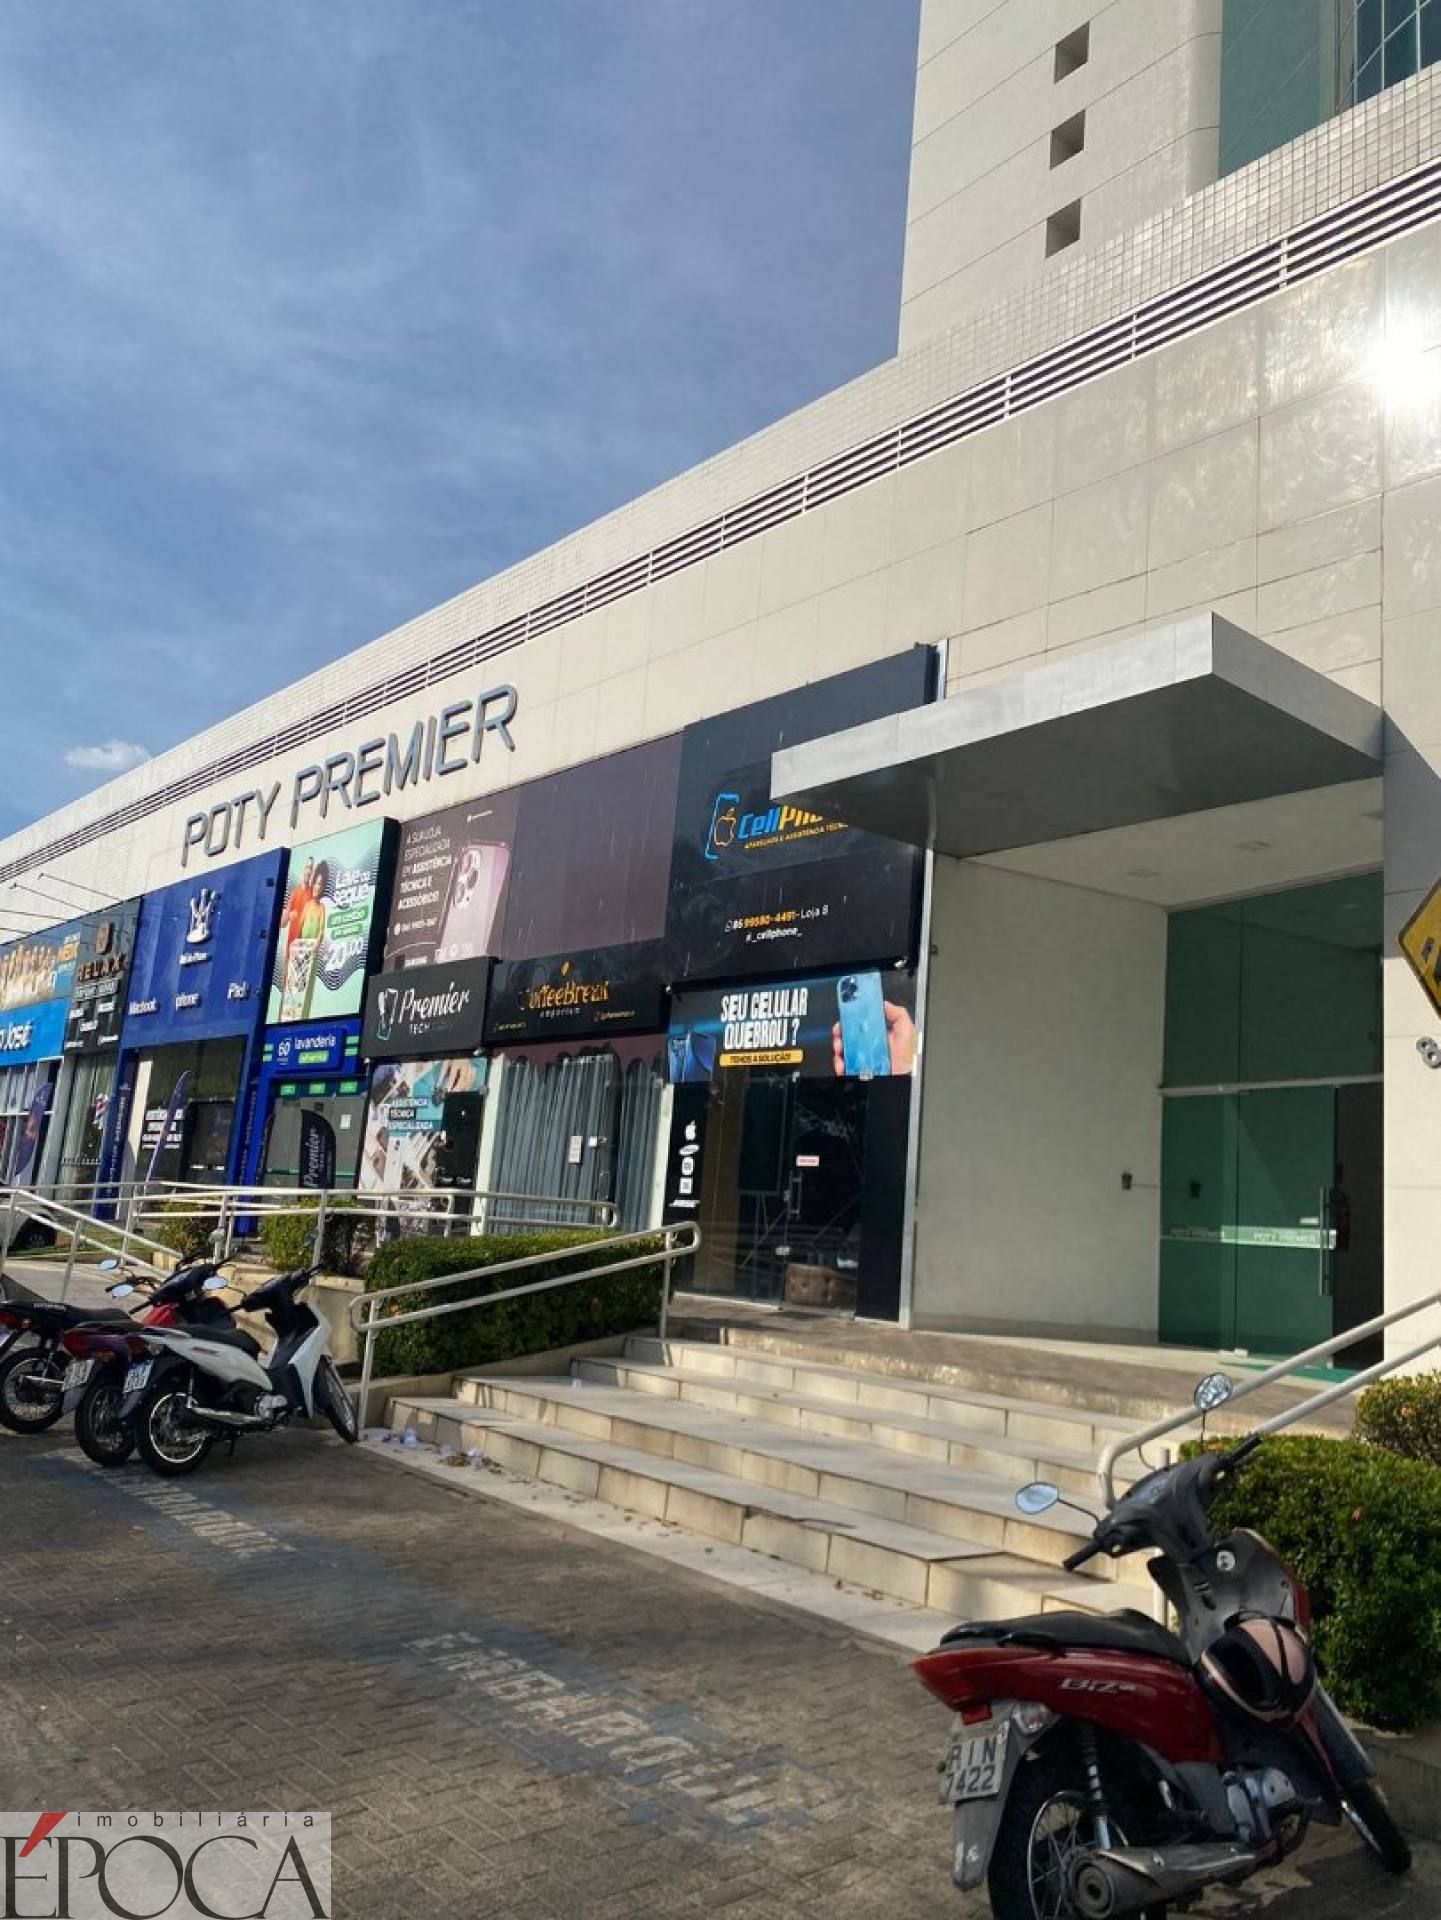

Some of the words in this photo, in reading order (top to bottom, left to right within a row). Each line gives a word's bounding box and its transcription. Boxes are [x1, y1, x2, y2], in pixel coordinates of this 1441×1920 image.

[181, 781, 282, 868] POTY
[289, 684, 518, 830] PREMIER
[737, 804, 823, 842] CellPh
[721, 993, 750, 1023] SEU
[749, 987, 809, 1021] CELULAR
[295, 1033, 337, 1050] lavanderia
[724, 1021, 789, 1050] QUEBROU
[791, 1018, 801, 1047] ?
